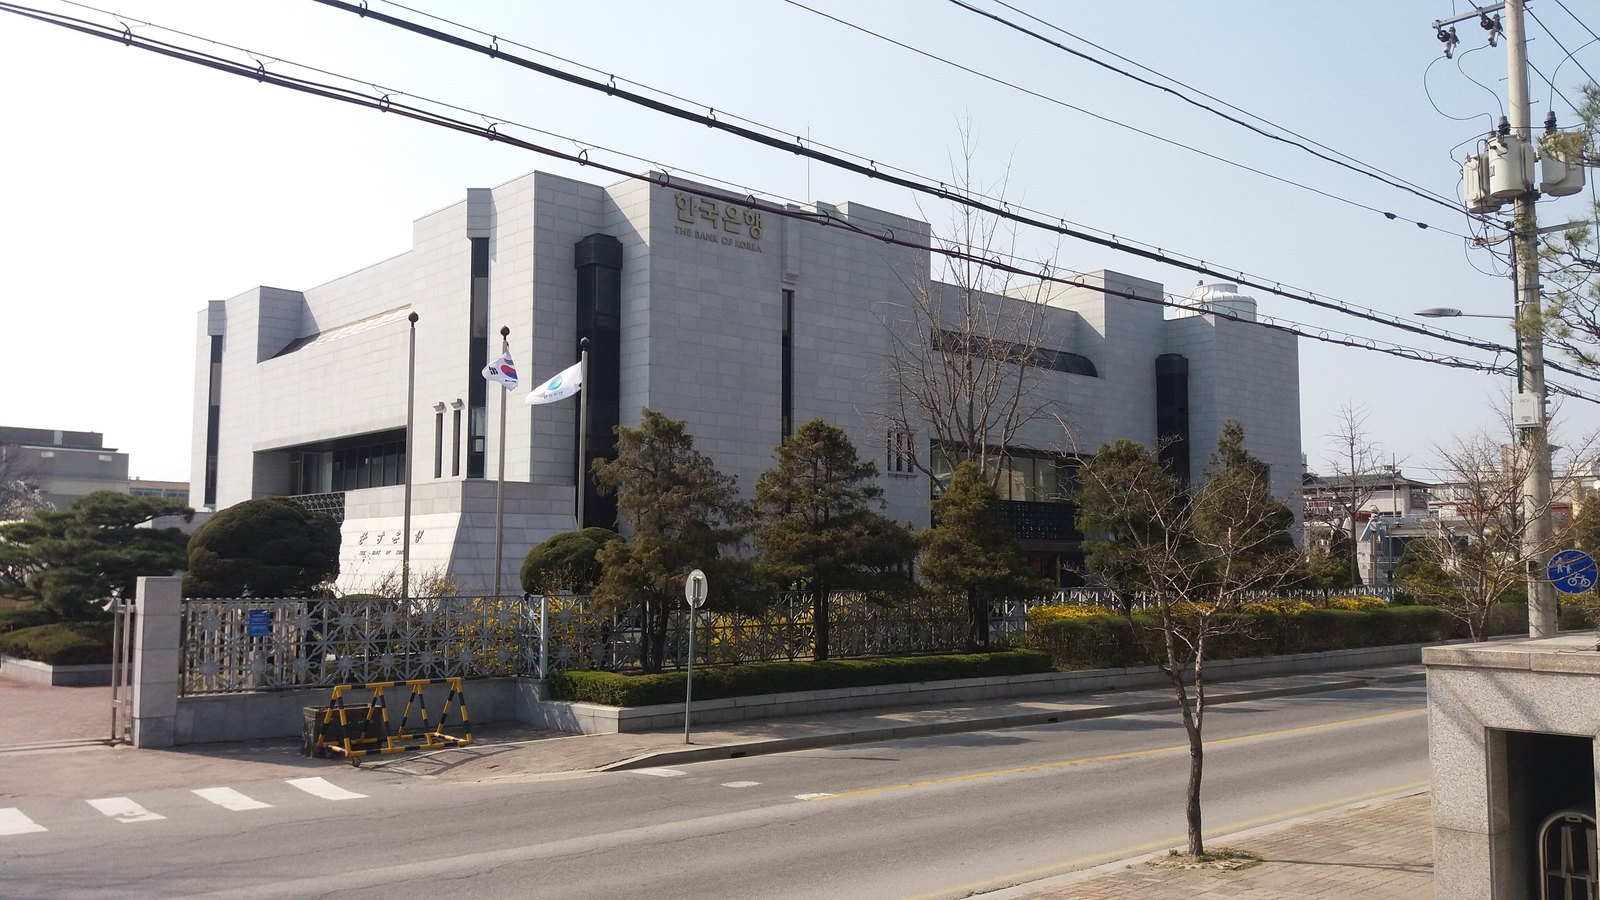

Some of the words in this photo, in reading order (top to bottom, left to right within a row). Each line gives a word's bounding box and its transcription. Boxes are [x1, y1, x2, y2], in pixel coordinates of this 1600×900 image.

[674, 192, 763, 240] 한국은행
[674, 225, 692, 237] THE
[694, 230, 718, 244] BANK
[720, 236, 734, 246] OF
[734, 240, 762, 253] KOREA
